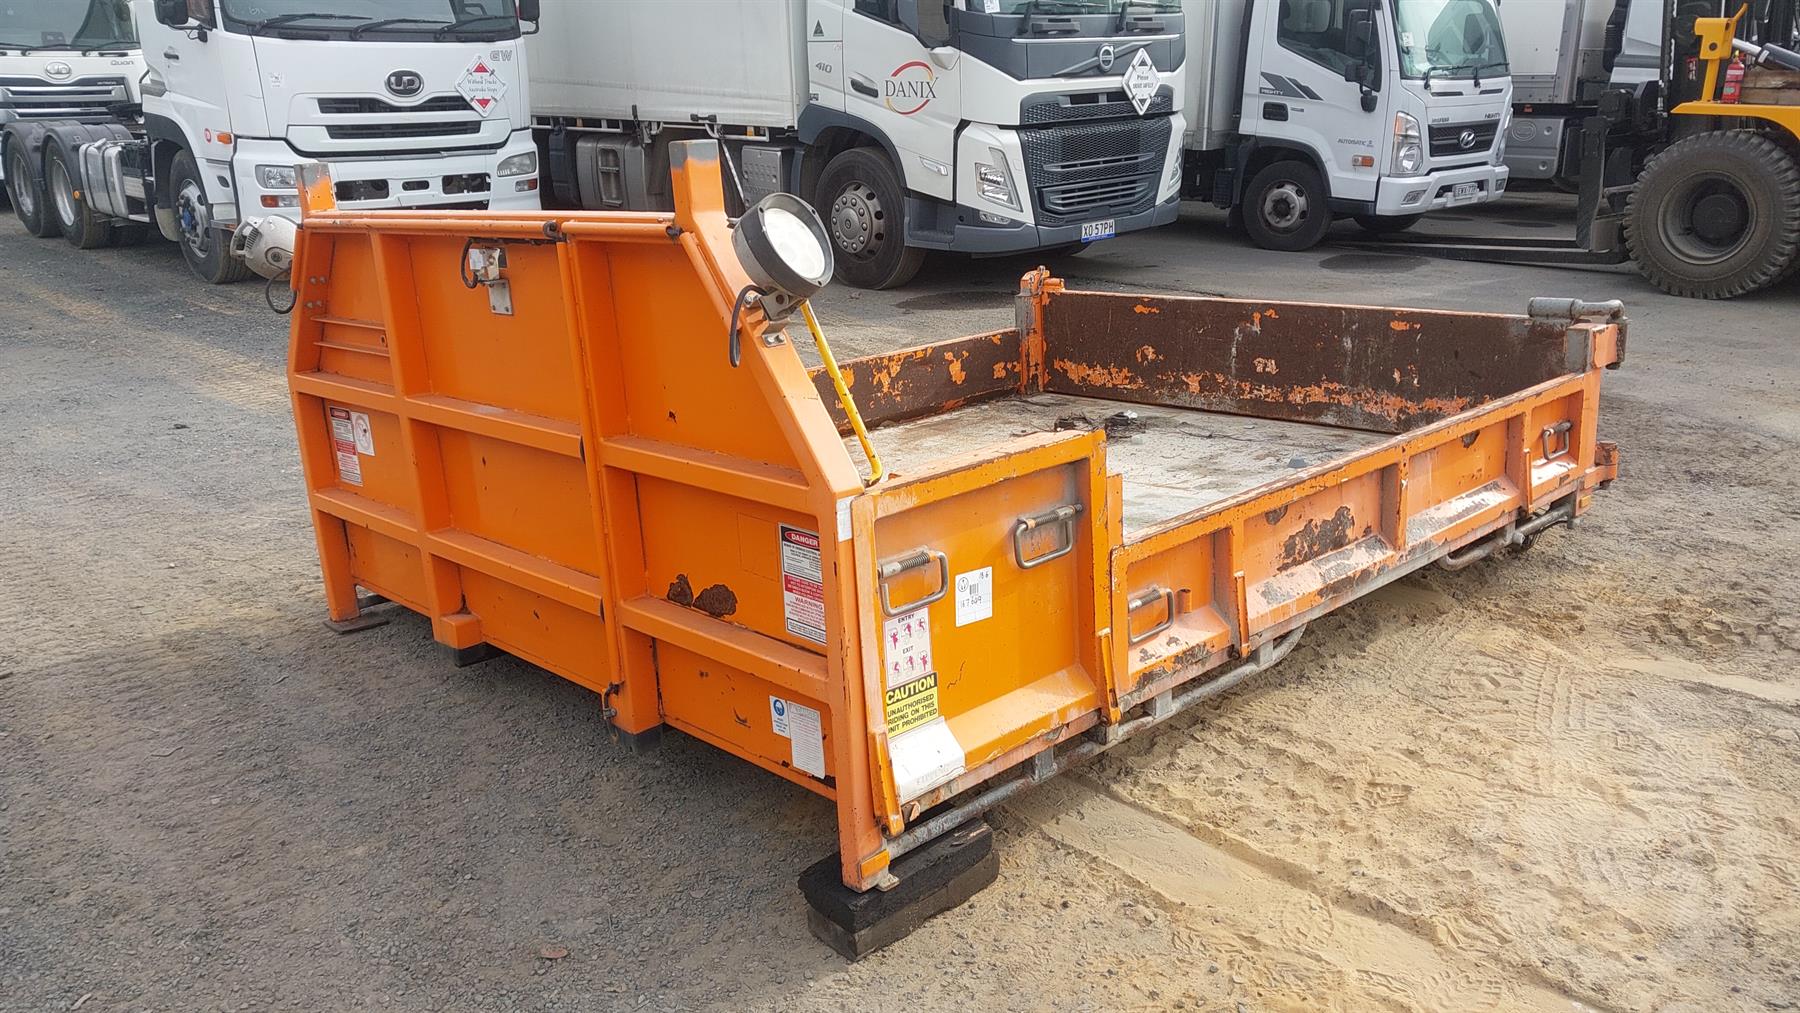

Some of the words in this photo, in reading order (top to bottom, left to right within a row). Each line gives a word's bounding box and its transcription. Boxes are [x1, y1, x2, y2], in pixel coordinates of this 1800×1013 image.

[815, 62, 832, 73] 410
[390, 76, 420, 89] UD
[885, 77, 939, 99] DANIX
[791, 533, 819, 547] DANGER
[794, 595, 823, 611] WARNING
[897, 613, 914, 624] ENTRY
[902, 645, 914, 654] EXIT
[886, 674, 935, 705] CAUTION
[887, 693, 935, 718] UNAUTHORISED
[887, 711, 909, 727] RIDING
[910, 707, 920, 716] ON
[921, 701, 935, 711] THIS
[901, 708, 938, 728] PROHIBITED
